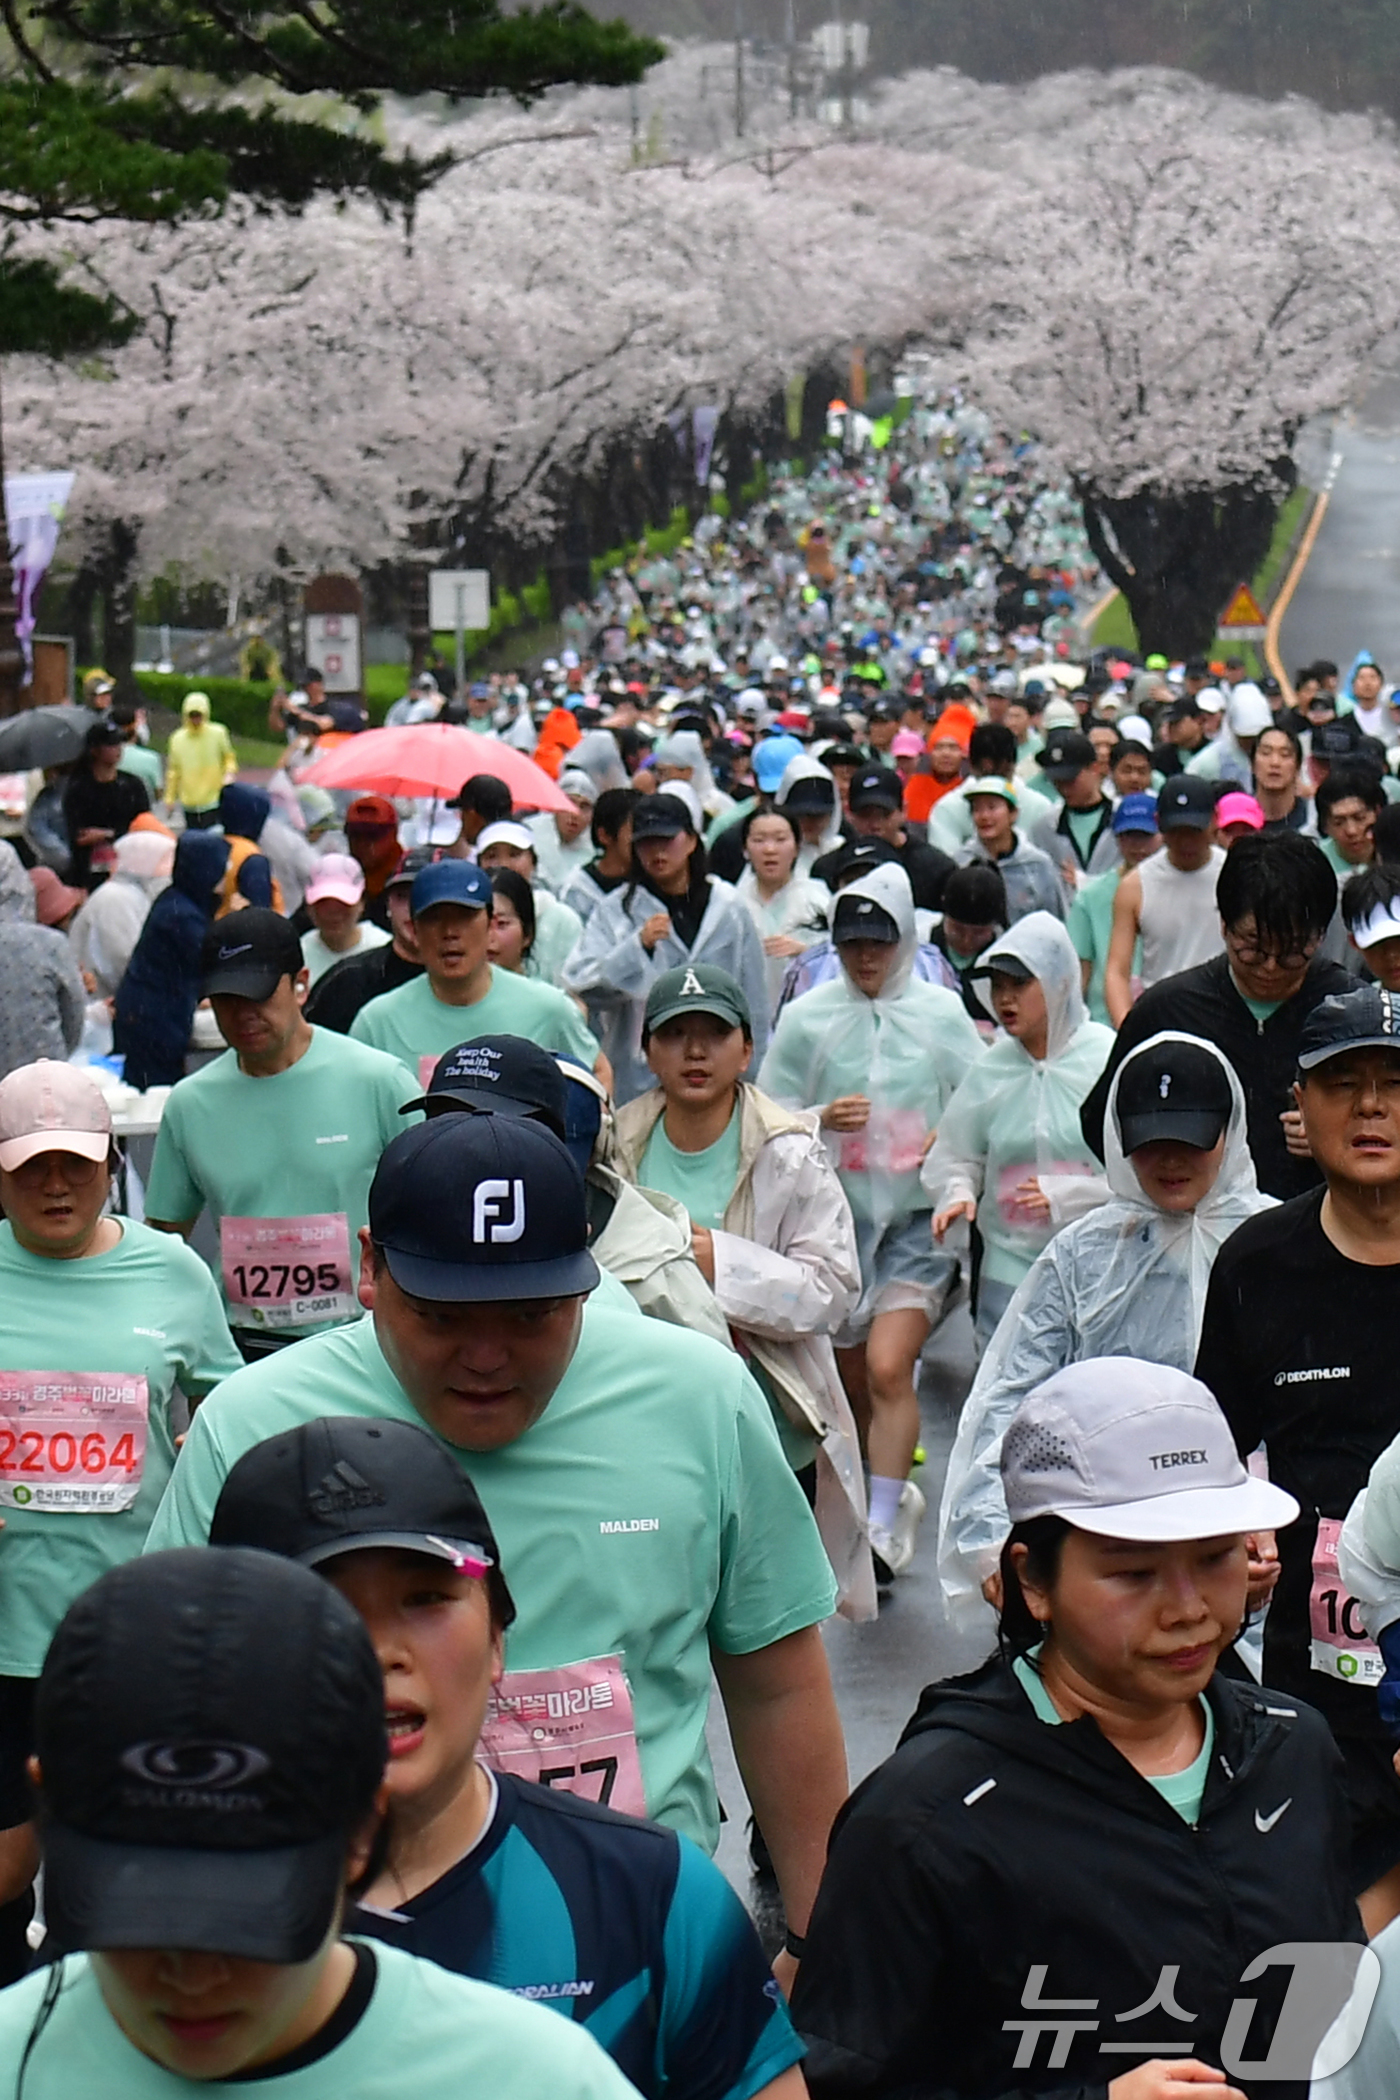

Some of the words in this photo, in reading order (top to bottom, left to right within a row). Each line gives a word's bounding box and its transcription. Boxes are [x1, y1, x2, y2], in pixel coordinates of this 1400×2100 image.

[456, 1048, 479, 1058] Keep
[480, 1047, 503, 1060] Our
[457, 1058, 489, 1068] health
[444, 1066, 461, 1077] The
[462, 1067, 500, 1081] holiday
[473, 1179, 525, 1243] FJ
[233, 1263, 340, 1298] 12795
[296, 1297, 338, 1314] C-0081
[1287, 1366, 1350, 1383] DECATHLON
[0, 1430, 137, 1474] 22064
[1149, 1449, 1209, 1470] TERREX
[600, 1518, 659, 1534] MALDEN
